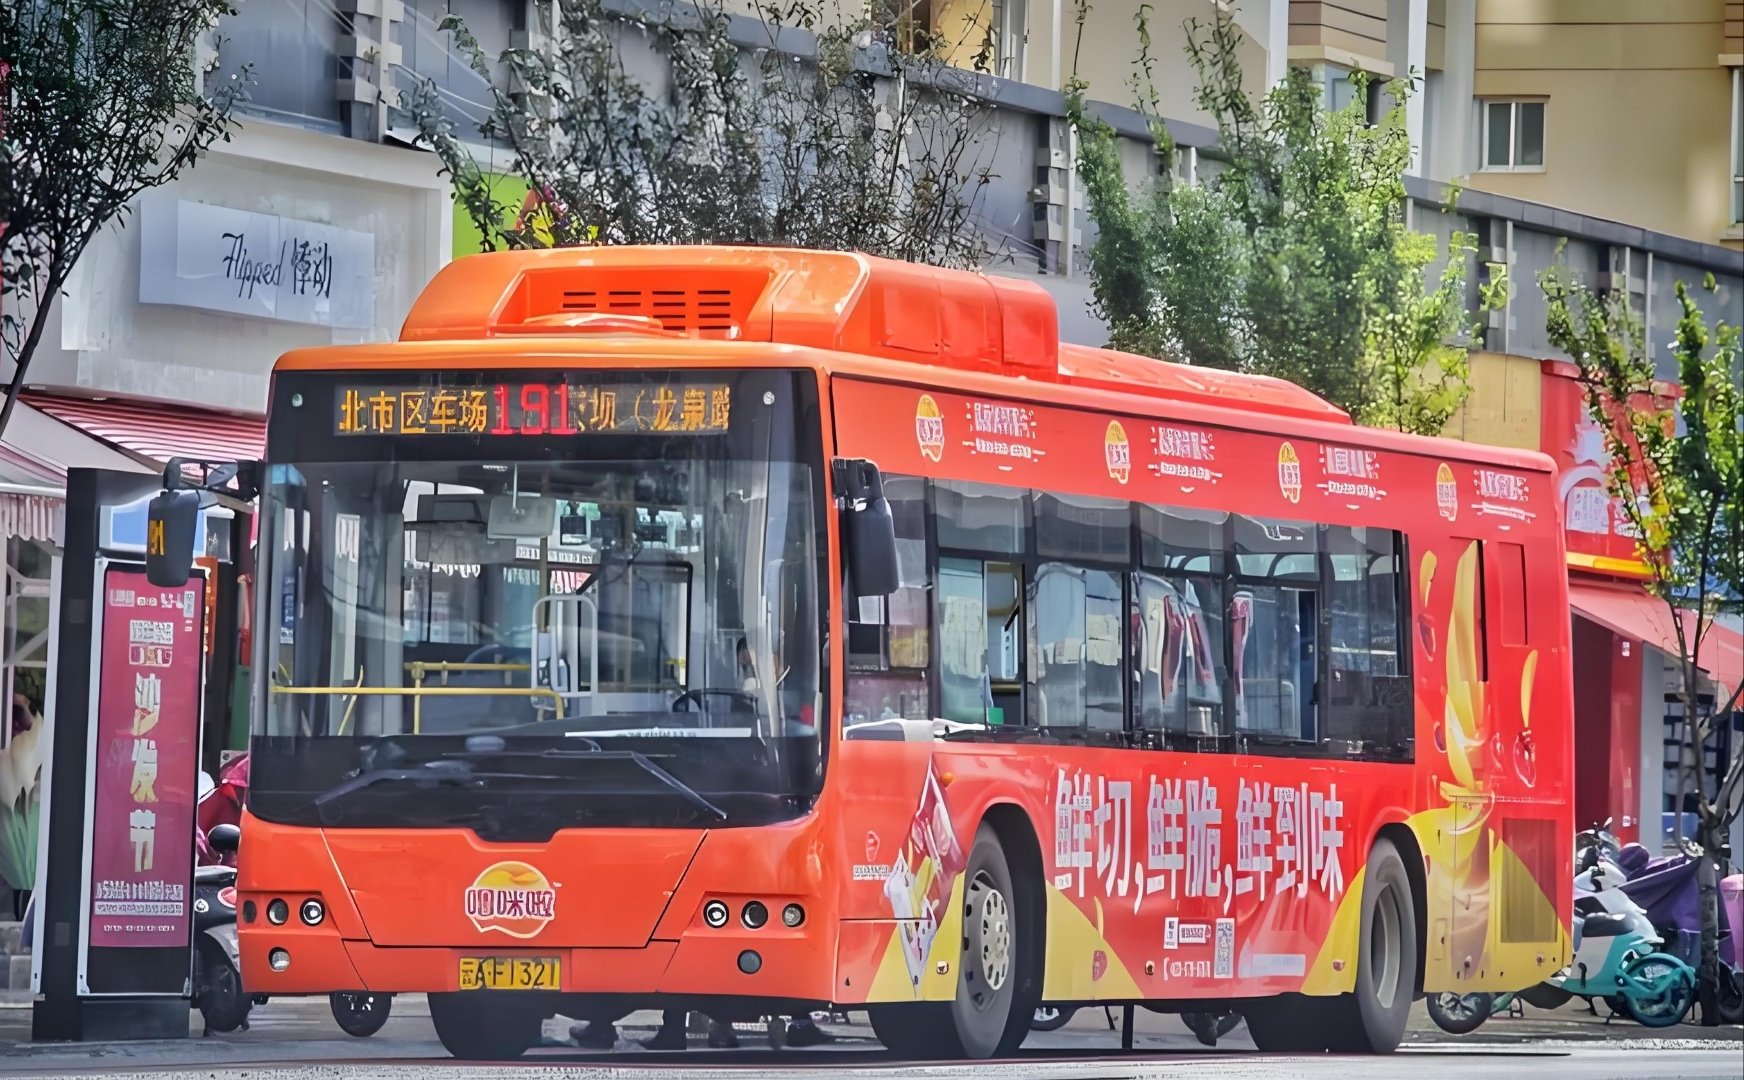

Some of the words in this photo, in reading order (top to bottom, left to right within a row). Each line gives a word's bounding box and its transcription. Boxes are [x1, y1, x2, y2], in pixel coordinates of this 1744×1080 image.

[222, 233, 286, 299] Flipped
[339, 389, 488, 434] 北市区车场
[491, 383, 578, 435] 191
